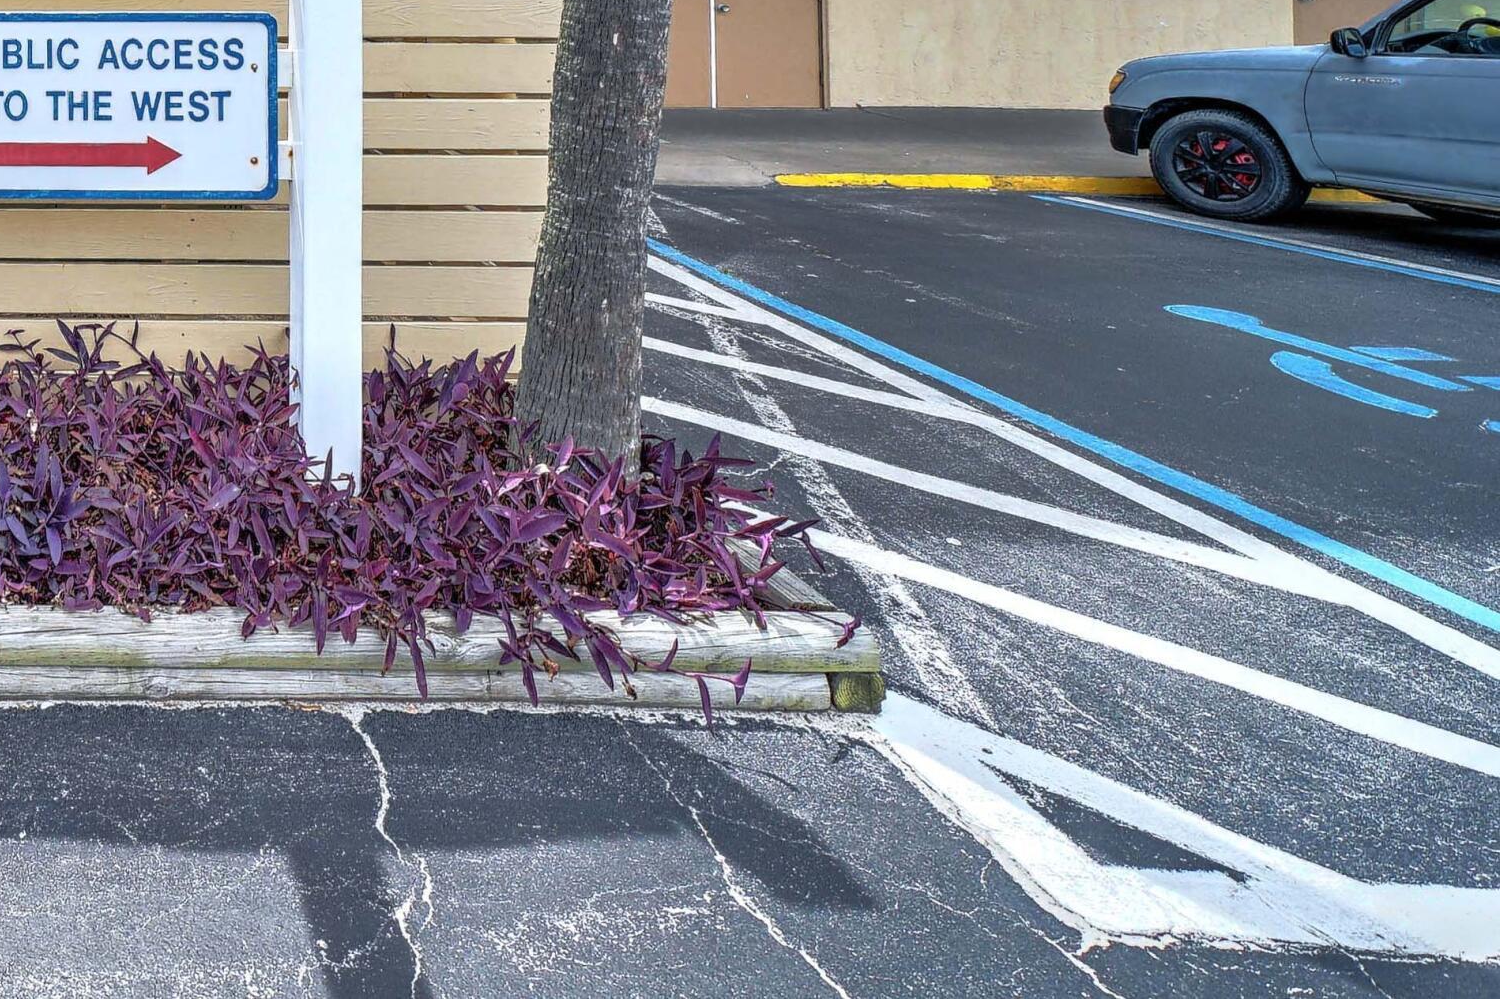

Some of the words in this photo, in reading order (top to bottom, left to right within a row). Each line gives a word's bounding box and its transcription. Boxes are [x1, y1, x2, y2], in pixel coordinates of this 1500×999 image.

[98, 38, 244, 70] ACCESS
[46, 91, 112, 121] THE
[131, 90, 231, 122] WEST
